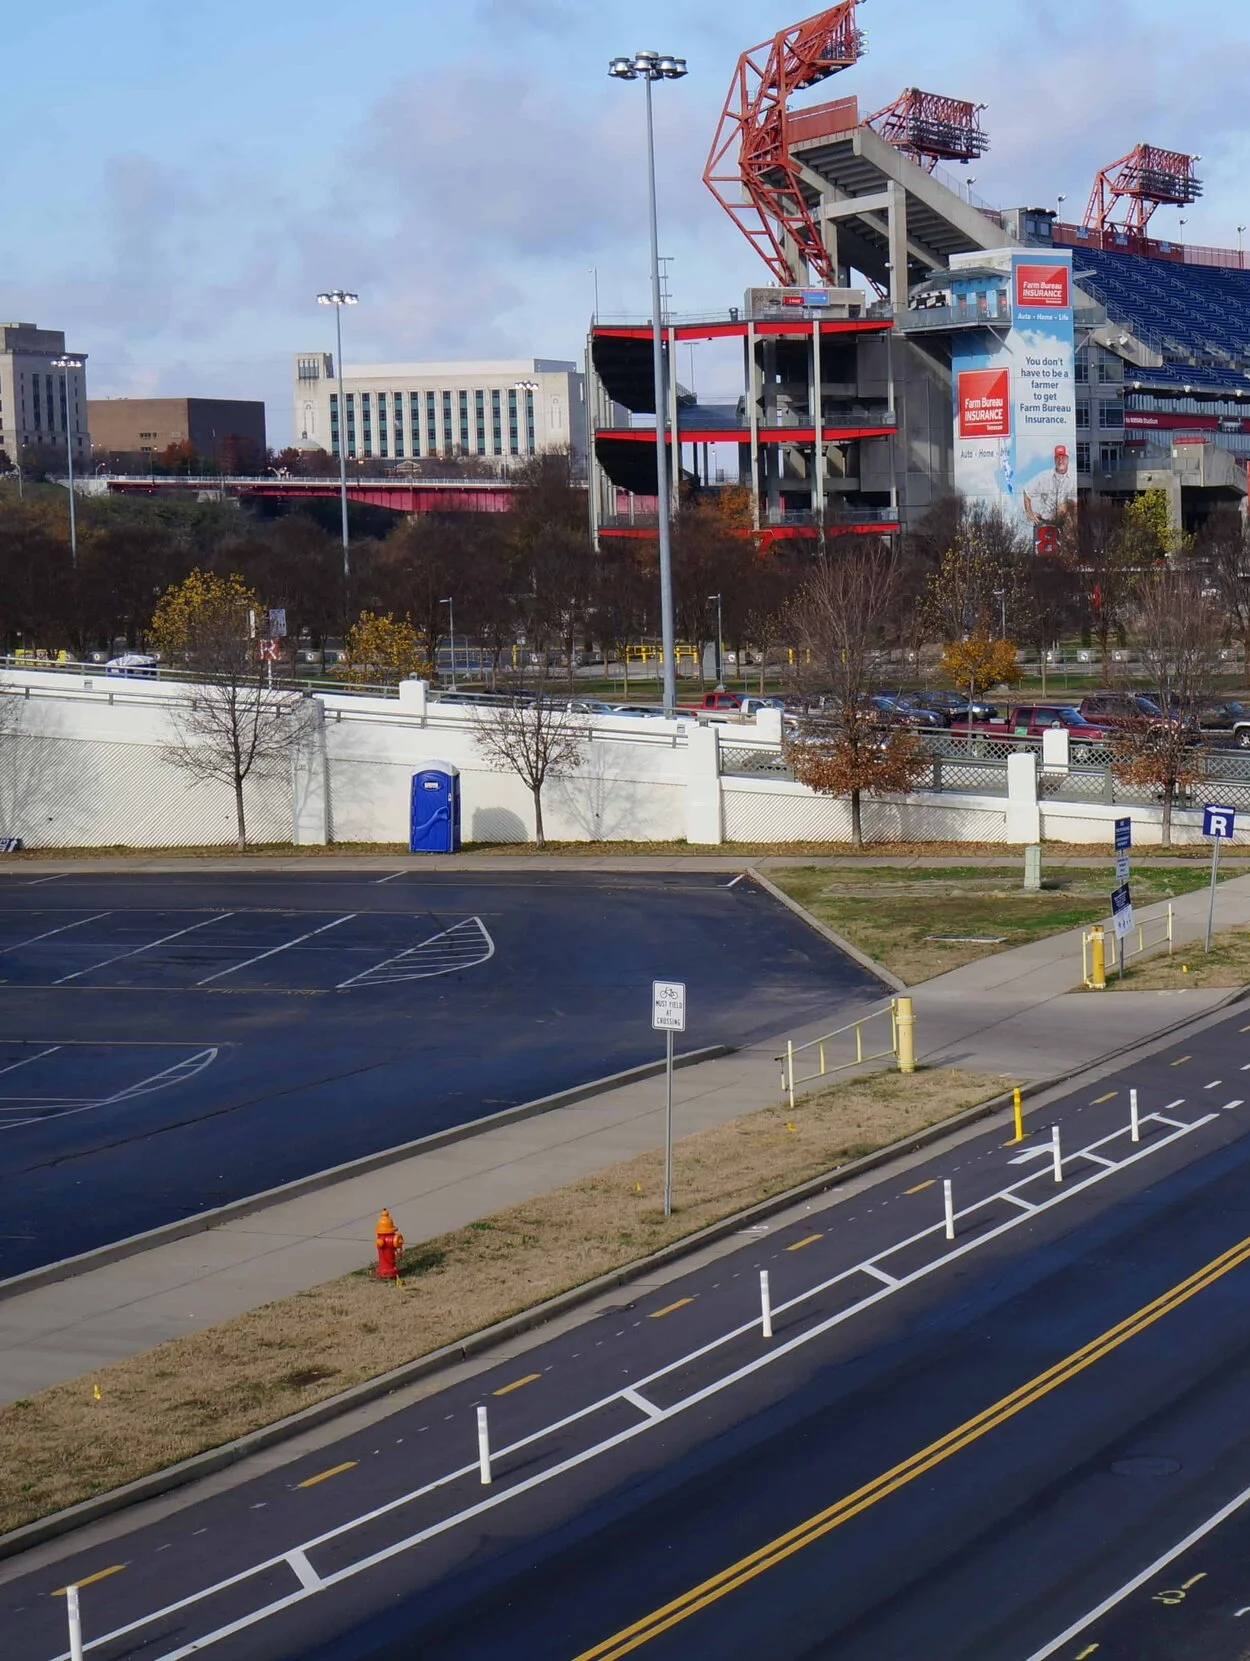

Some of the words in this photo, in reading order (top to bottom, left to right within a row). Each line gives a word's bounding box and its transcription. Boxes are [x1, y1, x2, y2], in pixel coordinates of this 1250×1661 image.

[1023, 281, 1040, 289] Farm
[1040, 281, 1062, 290] Bureau
[1023, 289, 1062, 298] INSURANCE
[1025, 357, 1041, 366] You
[1042, 356, 1063, 366] don't
[1021, 368, 1042, 377] have
[1043, 369, 1051, 377] to
[1052, 368, 1063, 378] be
[1031, 379, 1059, 389] farmer
[1033, 392, 1042, 400] to
[1043, 393, 1057, 403] get
[965, 398, 981, 409] Farm
[981, 397, 1003, 408] Bureau
[1020, 403, 1041, 412] Farm
[1042, 403, 1071, 413] Bureau
[965, 409, 1003, 421] INSURANCE
[1025, 415, 1067, 424] Insurance.
[1209, 816, 1227, 836] R
[669, 1001, 682, 1009] YIELD
[656, 1017, 681, 1026] CROSSING
